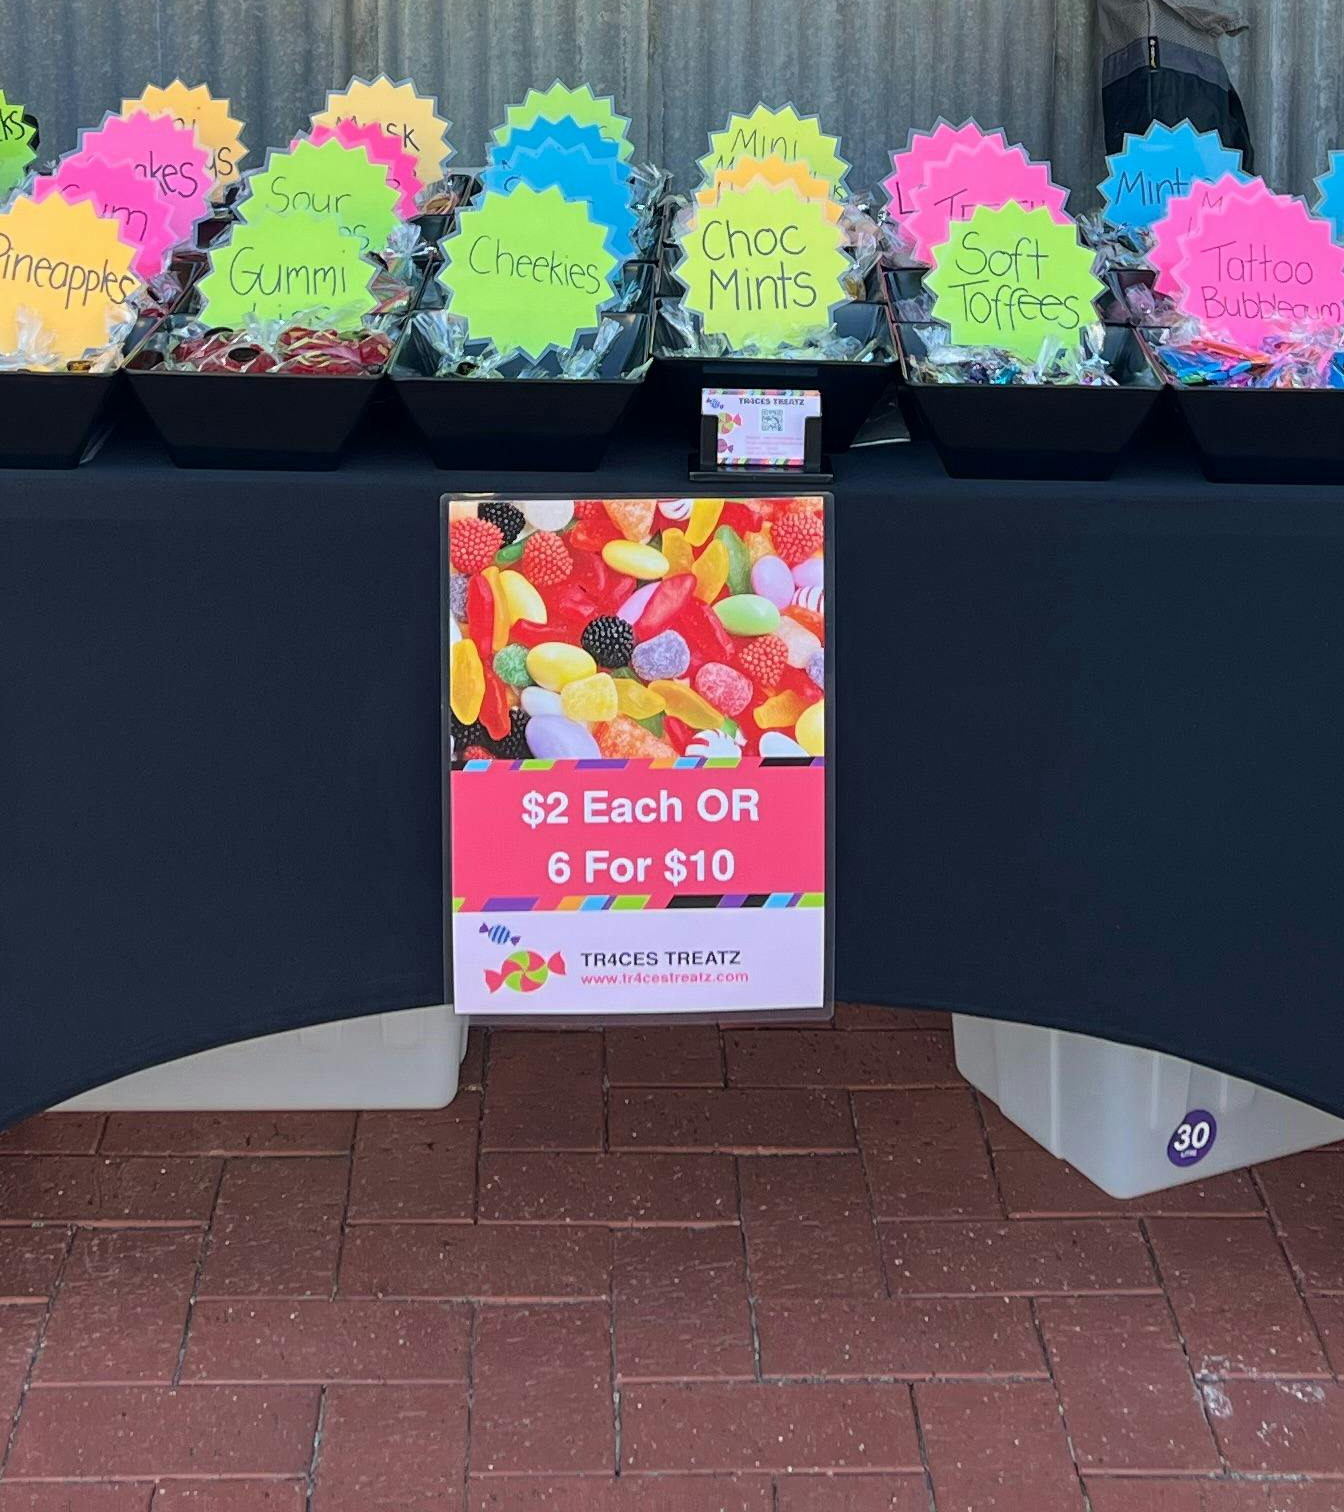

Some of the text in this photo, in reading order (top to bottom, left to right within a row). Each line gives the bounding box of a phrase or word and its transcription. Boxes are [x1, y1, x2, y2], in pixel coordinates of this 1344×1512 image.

[730, 127, 798, 161] Mini
[271, 176, 352, 215] Sour
[702, 220, 807, 261] Choc
[955, 231, 1049, 283] Soft
[229, 246, 346, 297] Gummi
[469, 235, 601, 295] Cheekies
[1201, 240, 1314, 285] Tattoo
[709, 261, 818, 311] Mints
[948, 279, 1080, 331] Toffees
[521, 788, 760, 829] $2 Each OR
[547, 847, 735, 887] 6 For $10
[580, 950, 742, 967] TR4CES TREATZ
[580, 970, 750, 986] www.tr4cestreatz.com
[1173, 1121, 1210, 1152] 30
